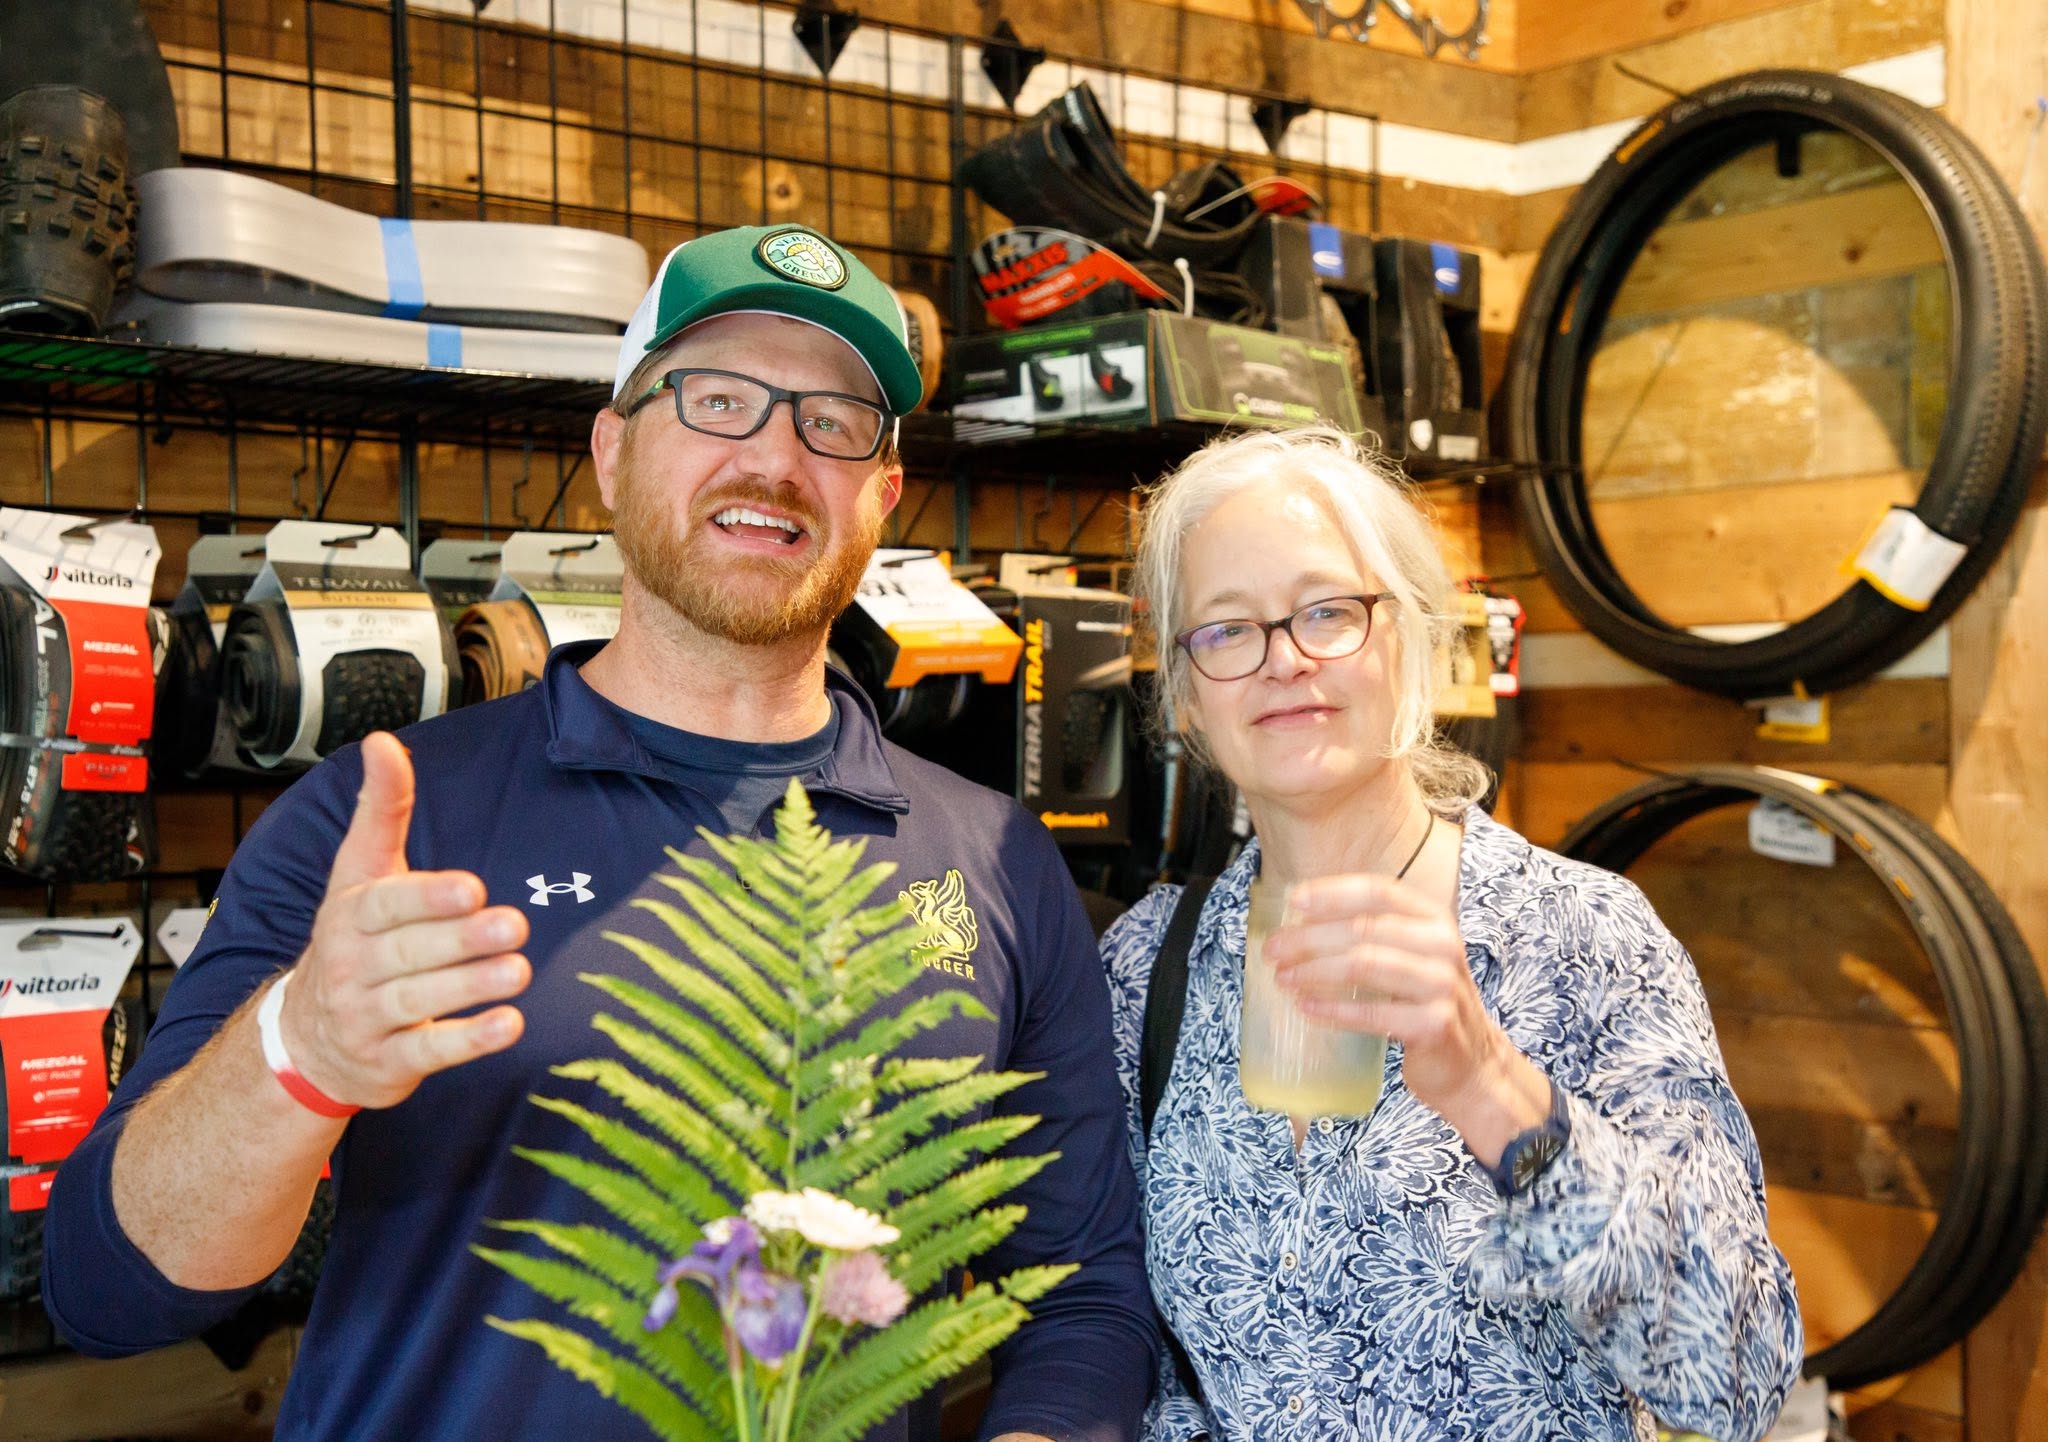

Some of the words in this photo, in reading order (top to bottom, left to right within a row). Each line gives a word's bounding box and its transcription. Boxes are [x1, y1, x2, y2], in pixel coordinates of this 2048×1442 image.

[776, 236, 836, 264] VERMONT
[783, 262, 826, 281] GREEN
[64, 569, 133, 588] vittoria
[293, 577, 409, 590] TERAVAIL
[83, 640, 139, 656] MEZCAL
[16, 972, 101, 995] vittoria
[21, 1055, 87, 1071] MEZCAL
